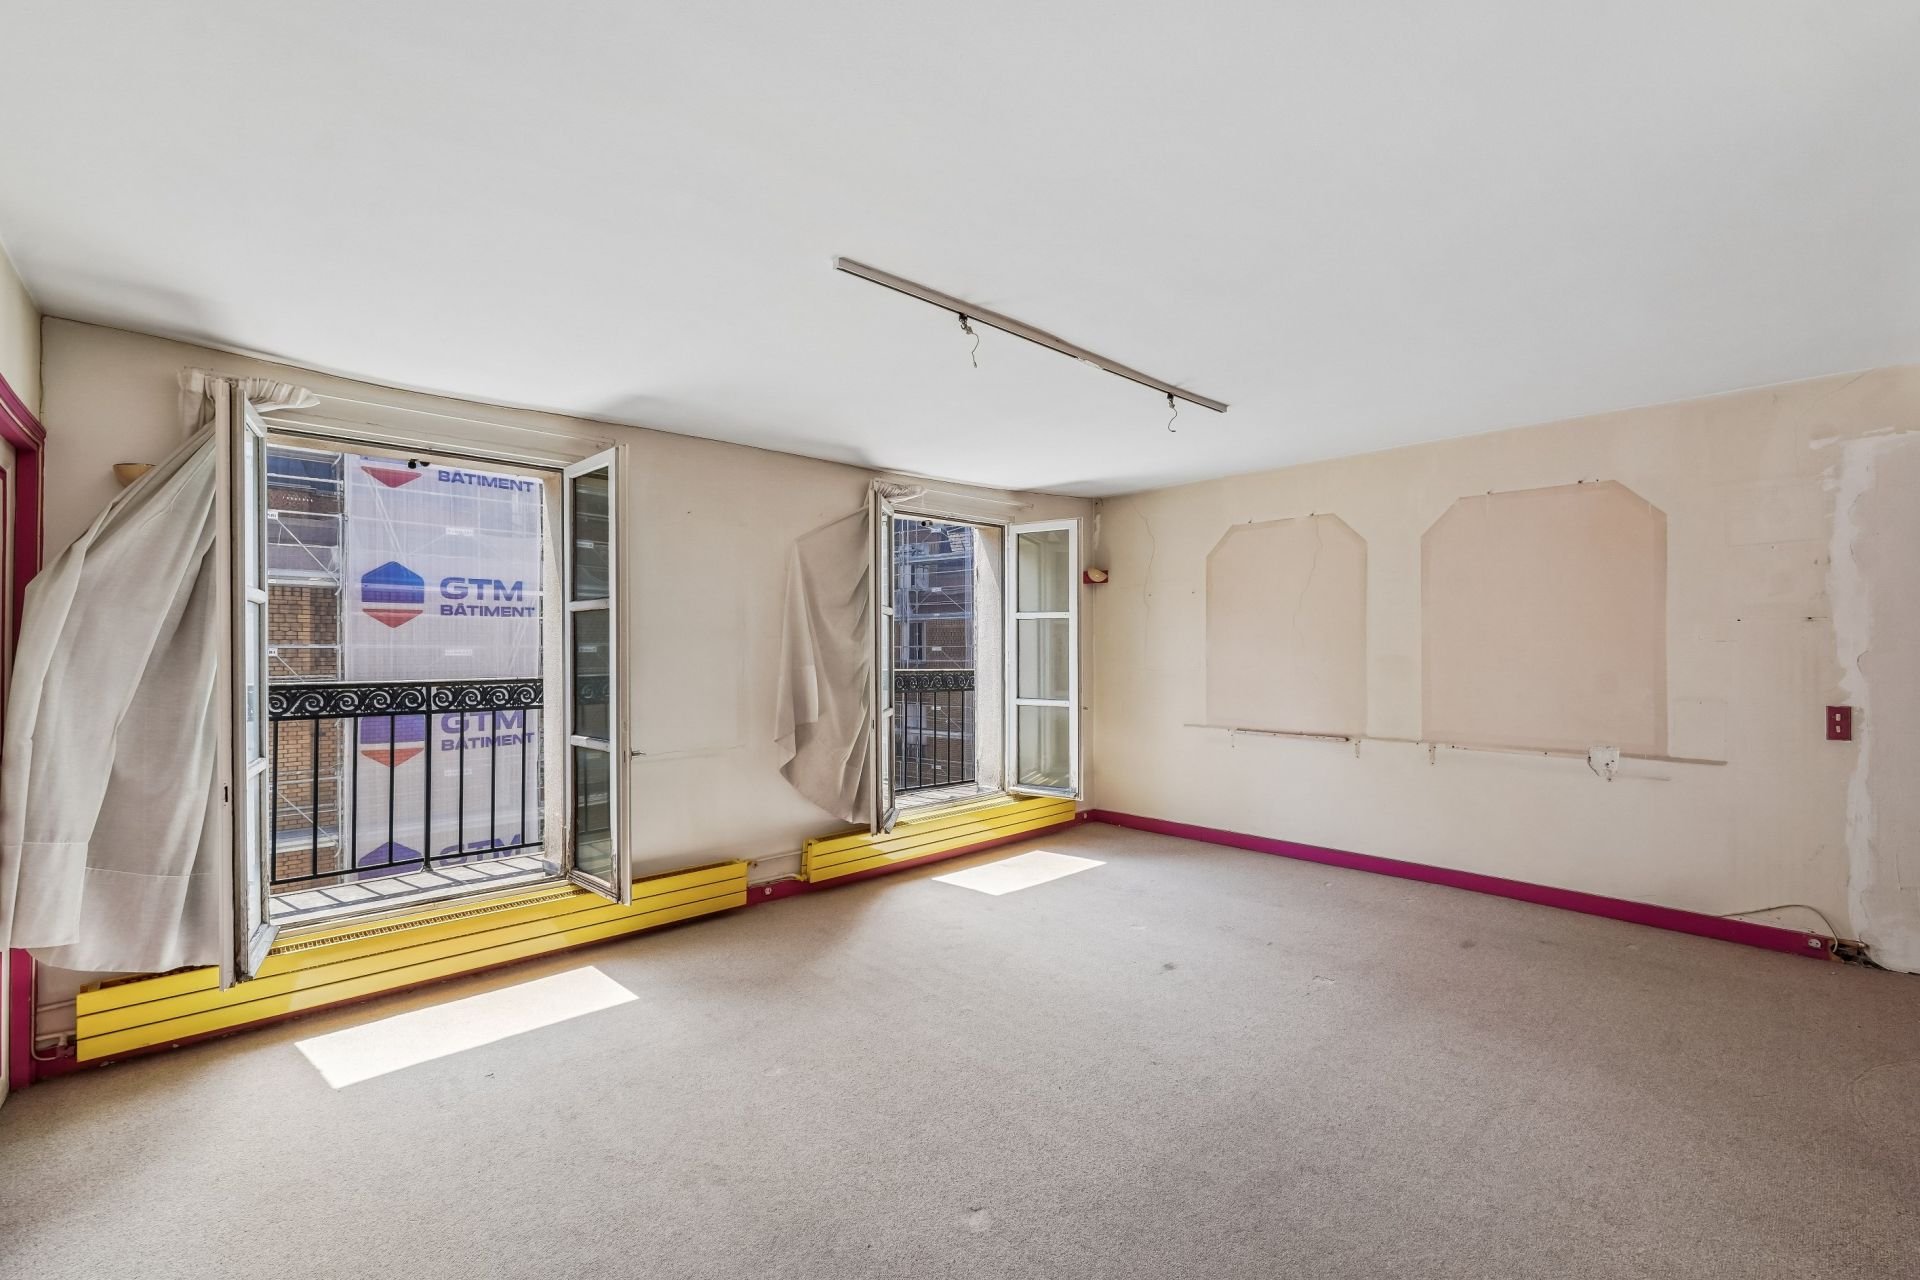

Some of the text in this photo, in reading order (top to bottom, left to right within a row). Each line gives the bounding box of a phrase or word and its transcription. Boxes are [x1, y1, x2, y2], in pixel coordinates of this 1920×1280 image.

[440, 577, 523, 602] GTM
[440, 602, 535, 617] BÂTIMENT
[441, 710, 524, 734] GTM
